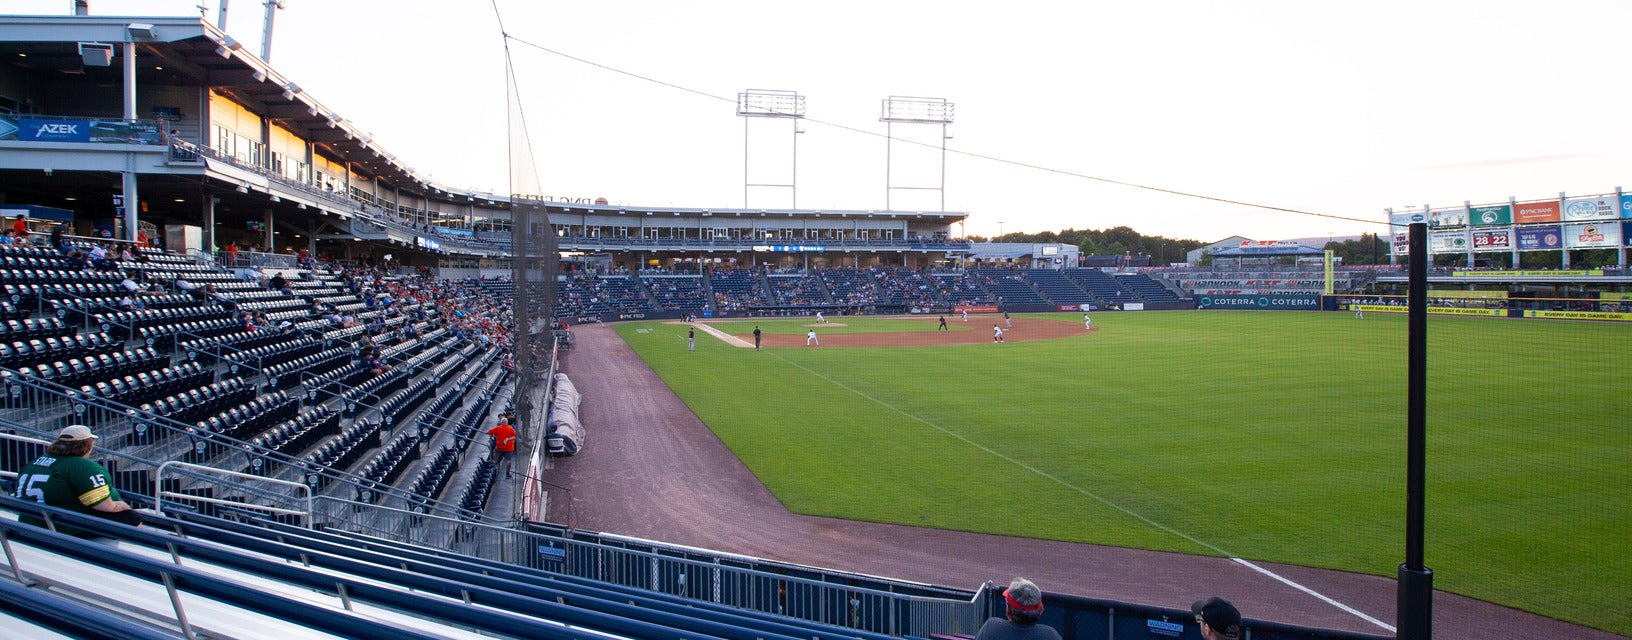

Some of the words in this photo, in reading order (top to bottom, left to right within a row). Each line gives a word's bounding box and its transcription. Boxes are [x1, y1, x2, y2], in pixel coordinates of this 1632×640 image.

[35, 124, 78, 138] AZEK
[1476, 236, 1488, 245] 28
[1493, 236, 1507, 244] 22
[16, 474, 50, 503] 15
[90, 474, 105, 488] 15
[1149, 620, 1182, 631] WARNING
